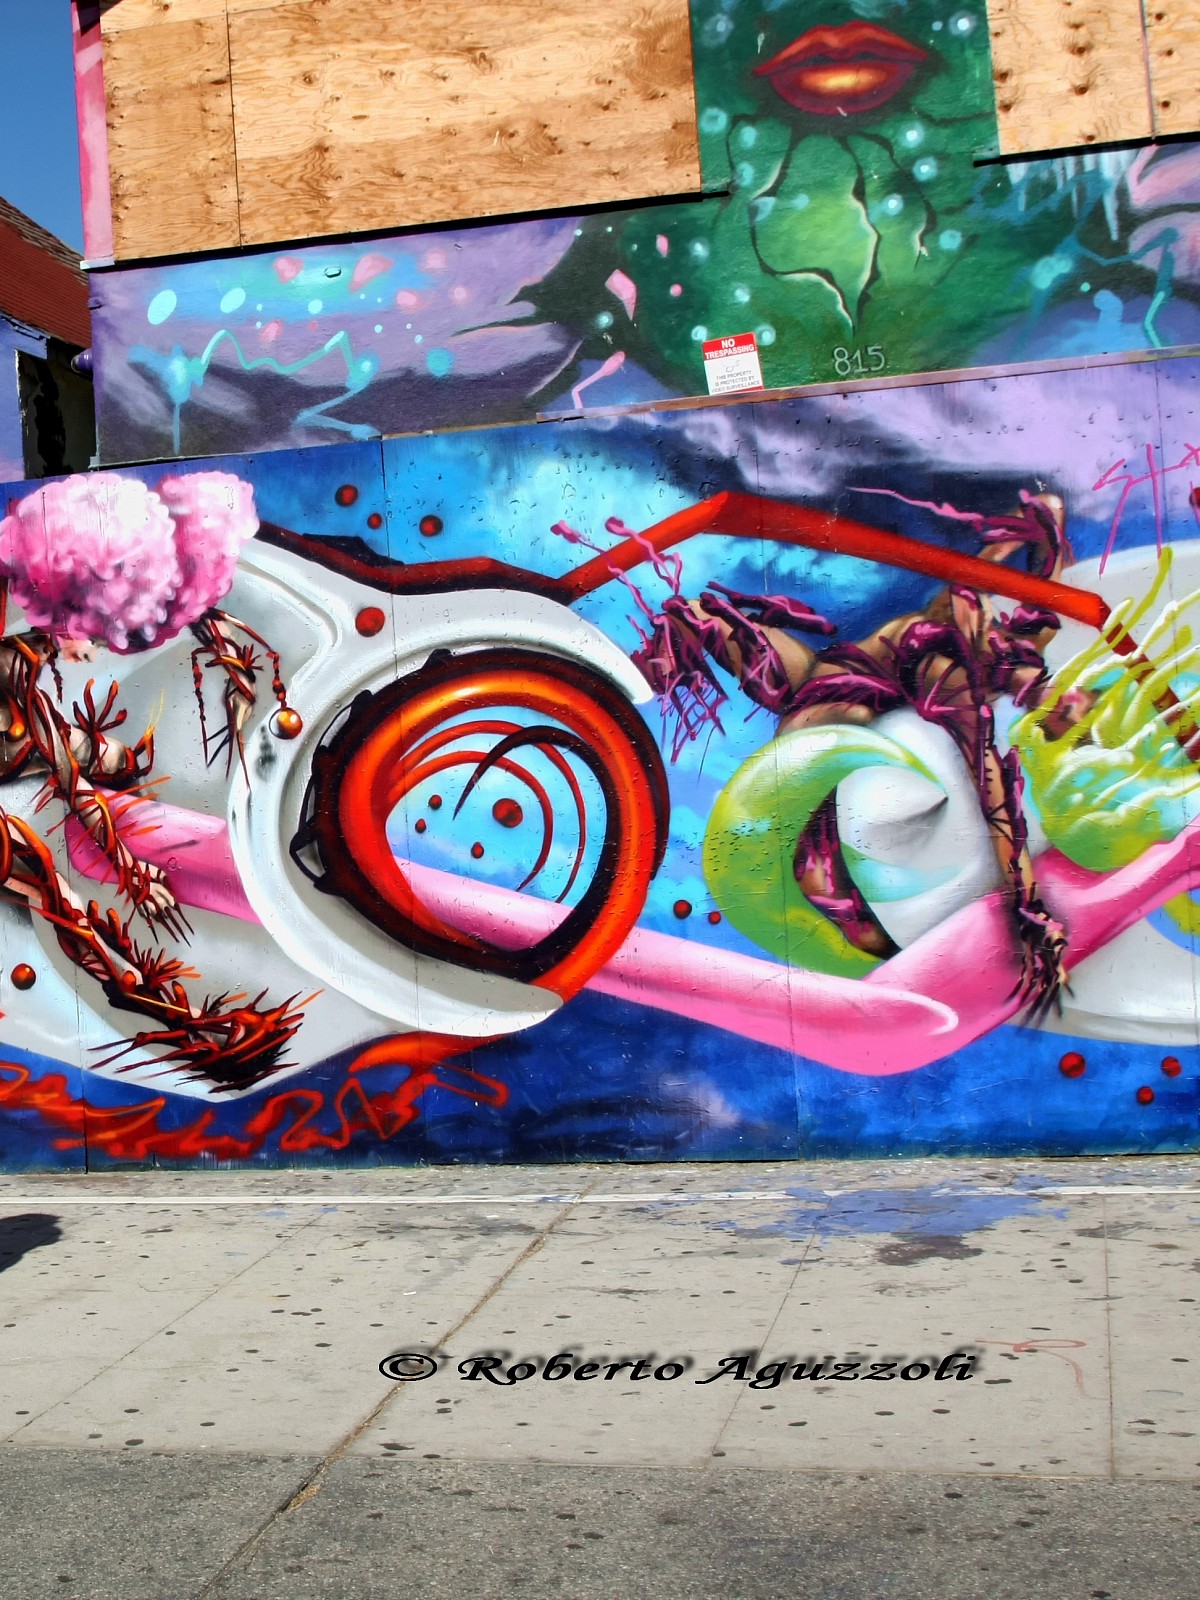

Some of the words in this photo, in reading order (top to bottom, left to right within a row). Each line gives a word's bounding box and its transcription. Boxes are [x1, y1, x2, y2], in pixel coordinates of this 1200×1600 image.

[721, 338, 736, 349] NO
[704, 343, 755, 360] TRESPASSING
[833, 346, 885, 375] 815
[727, 370, 752, 379] PROPERTY
[720, 376, 748, 386] PROTECTED
[726, 380, 760, 391] SURVEILLANCE
